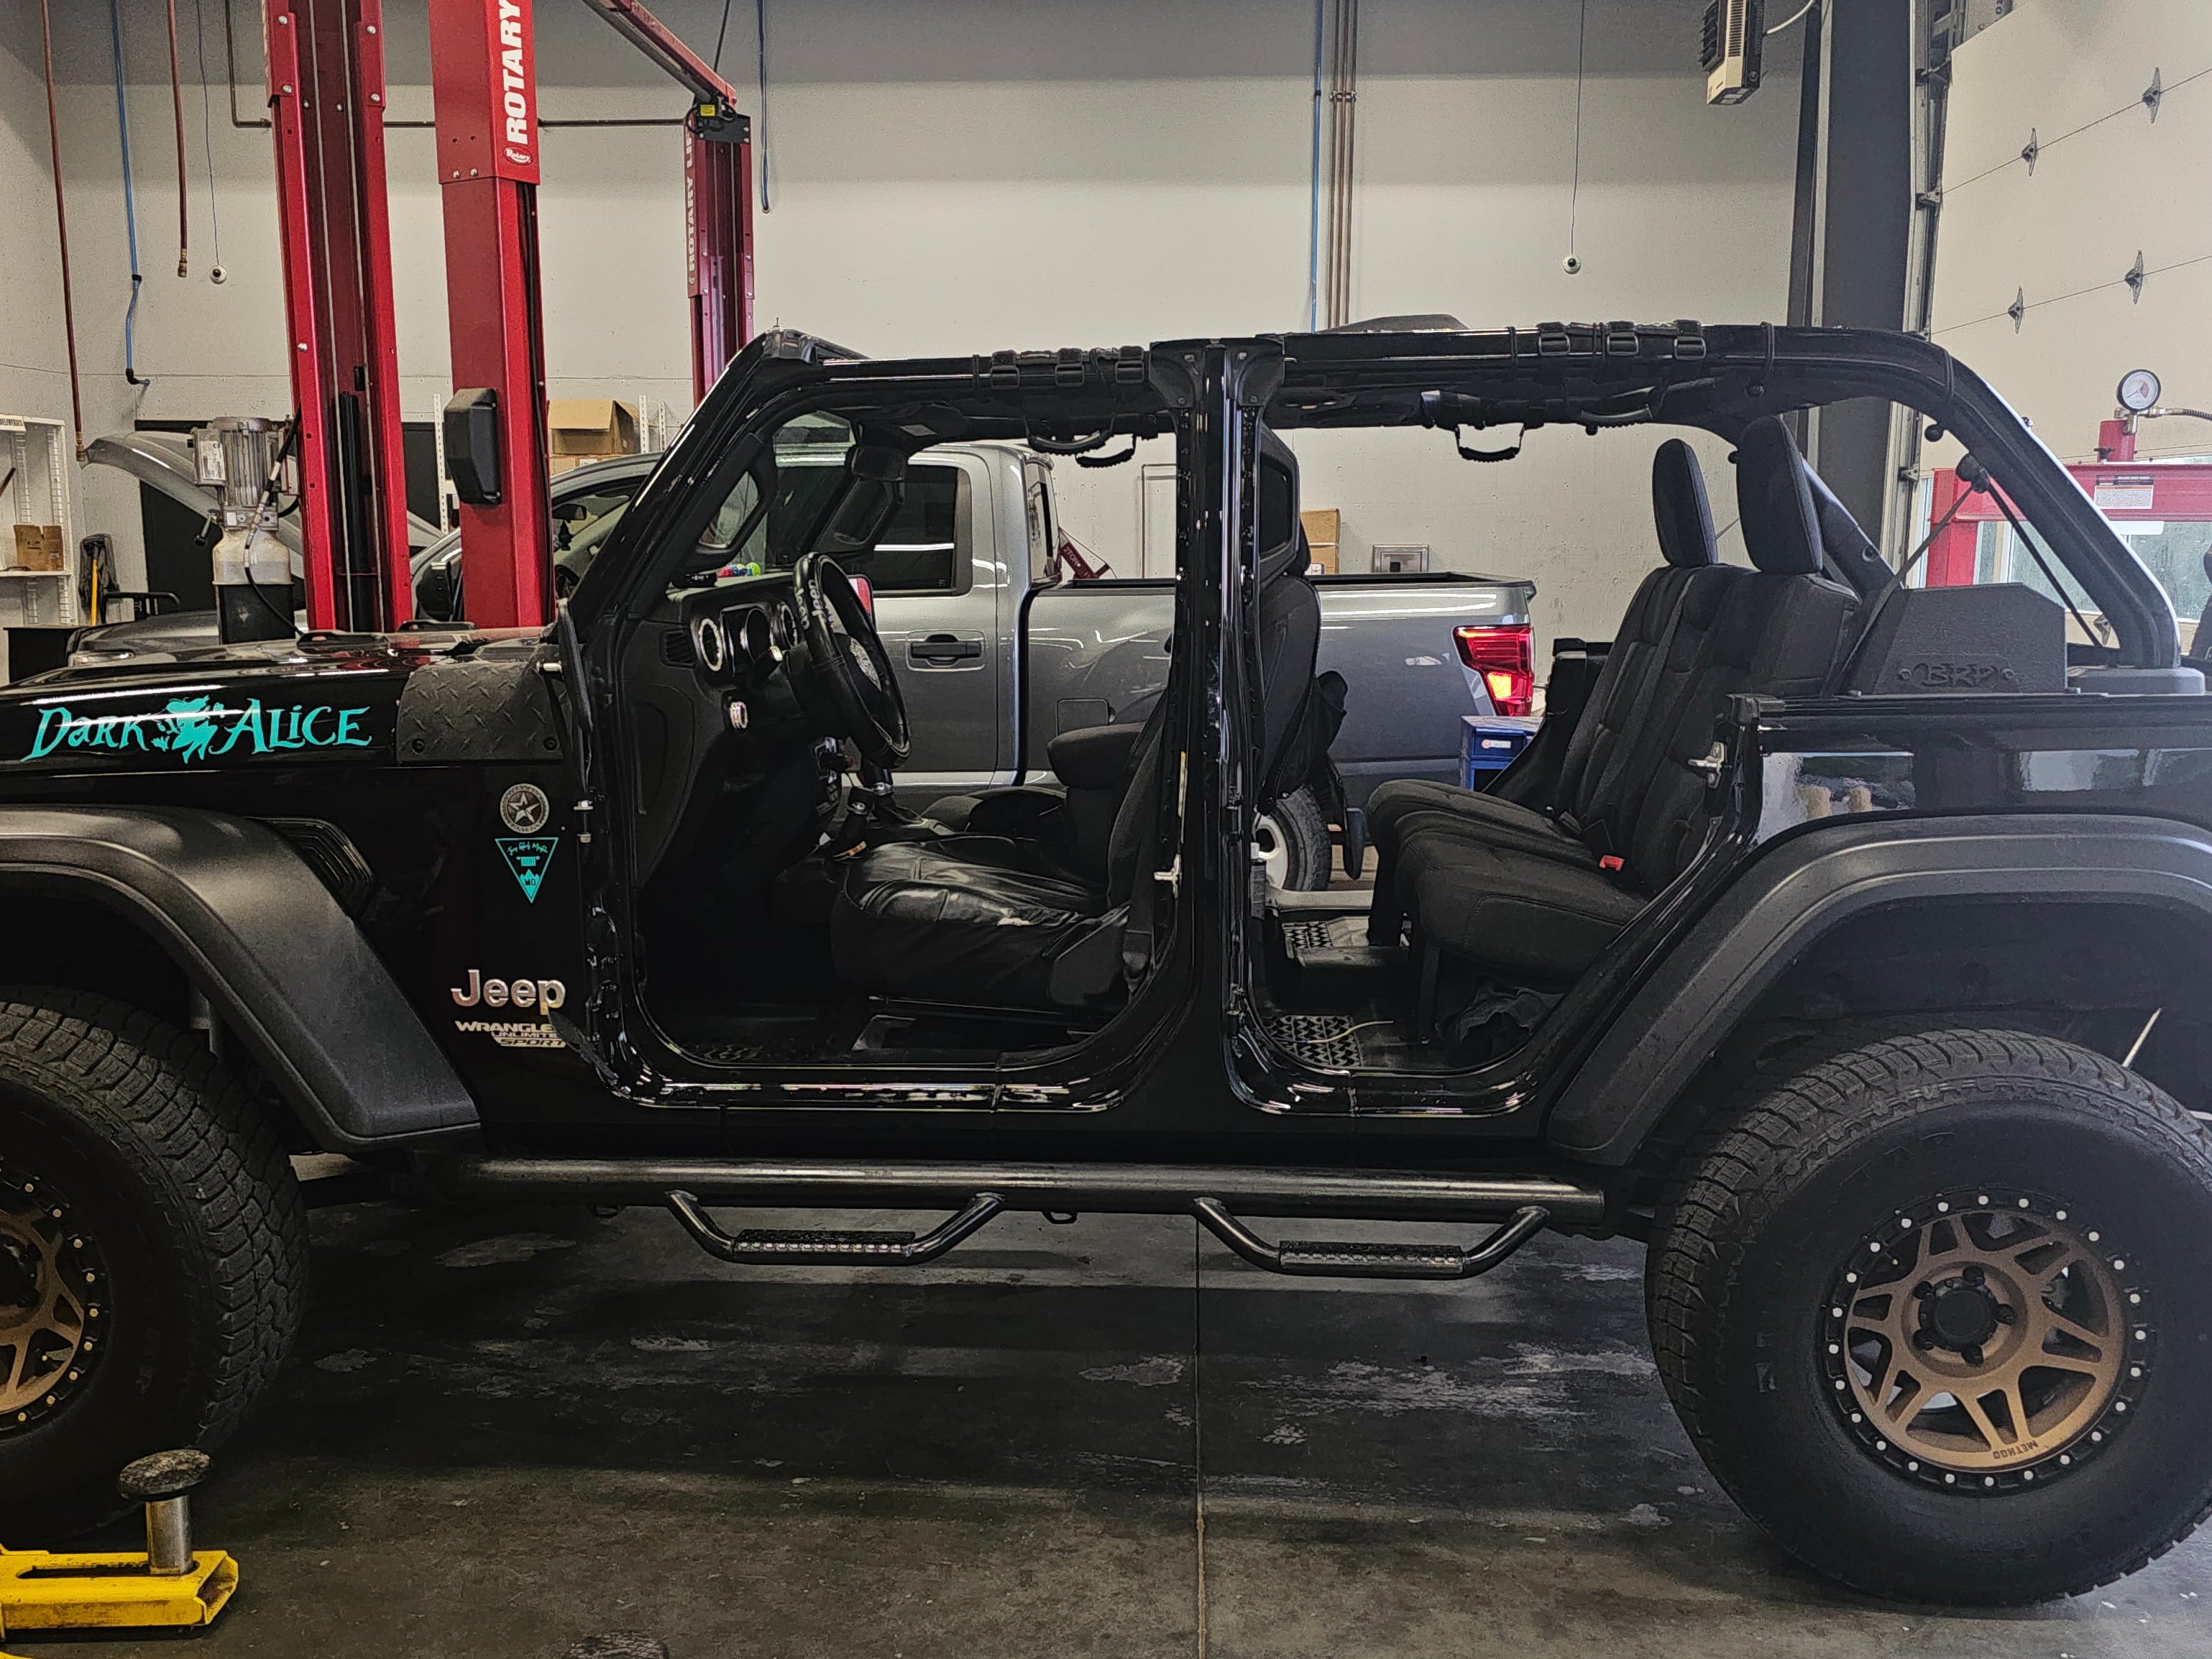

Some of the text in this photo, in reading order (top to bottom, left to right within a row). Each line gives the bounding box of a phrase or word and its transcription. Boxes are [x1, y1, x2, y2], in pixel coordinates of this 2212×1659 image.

[498, 0, 528, 144] ROTARY
[505, 147, 531, 163] Rotary
[450, 969, 566, 1015] Jeep
[454, 1021, 556, 1032] WRANGLE
[1992, 1440, 2039, 1460] METHOD
